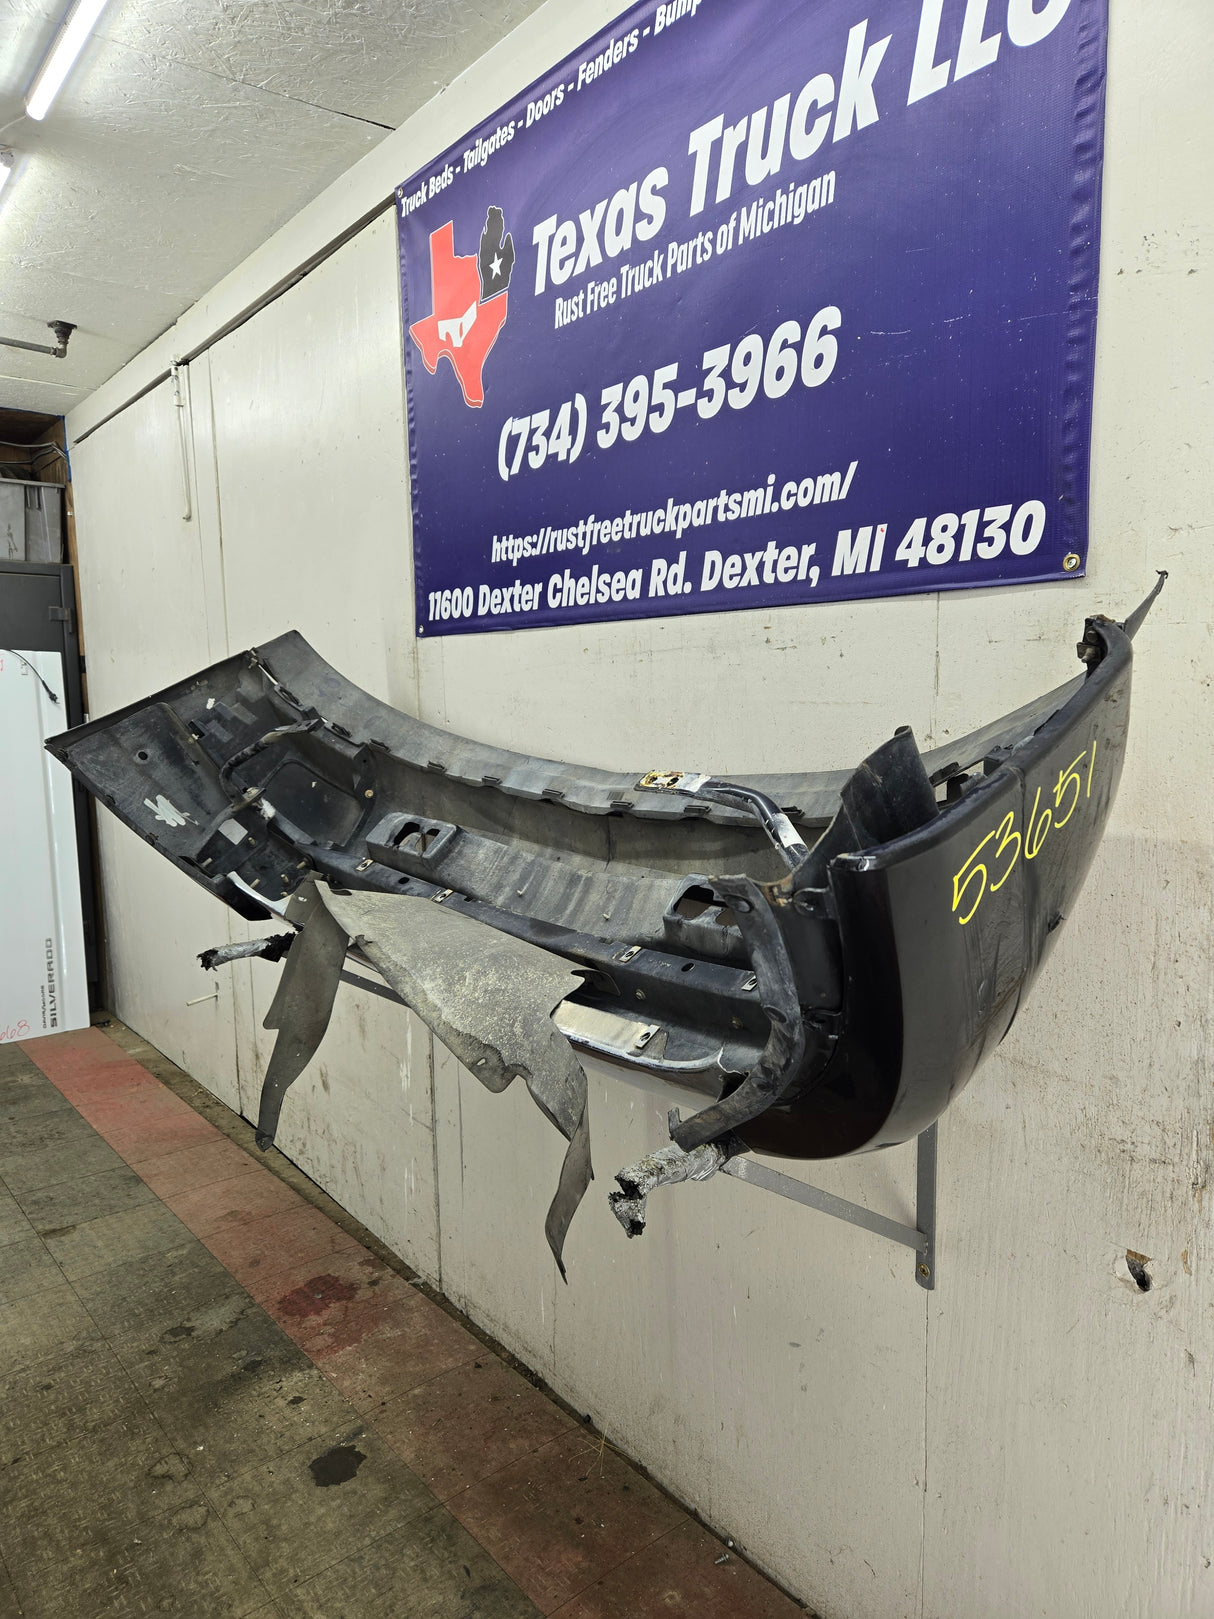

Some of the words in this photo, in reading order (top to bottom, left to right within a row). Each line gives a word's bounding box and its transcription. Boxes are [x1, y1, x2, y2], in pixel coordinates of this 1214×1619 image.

[400, 182, 427, 217] Truck
[428, 164, 454, 199] Beds
[463, 120, 516, 173] Tailgates
[526, 84, 564, 128] Doors
[577, 28, 639, 91] Fenders
[532, 166, 669, 296] Texas
[688, 19, 893, 217] Truck
[554, 282, 584, 329] Rust
[586, 269, 618, 314] Free
[620, 243, 664, 299] Truck
[666, 230, 713, 277] Parts
[716, 211, 737, 255] of
[738, 170, 836, 246] Michigan
[498, 393, 588, 481] (734)
[596, 306, 842, 449] 395-3966
[428, 586, 474, 621] 11600
[477, 579, 543, 616] Dexter
[547, 564, 643, 608] Chelsea
[648, 550, 692, 597] Rd.
[700, 540, 821, 591] Dexter,
[831, 523, 888, 577] MI
[894, 499, 1047, 568] 48130
[952, 740, 1098, 926] 53651
[45, 937, 58, 1028] SILVERADO
